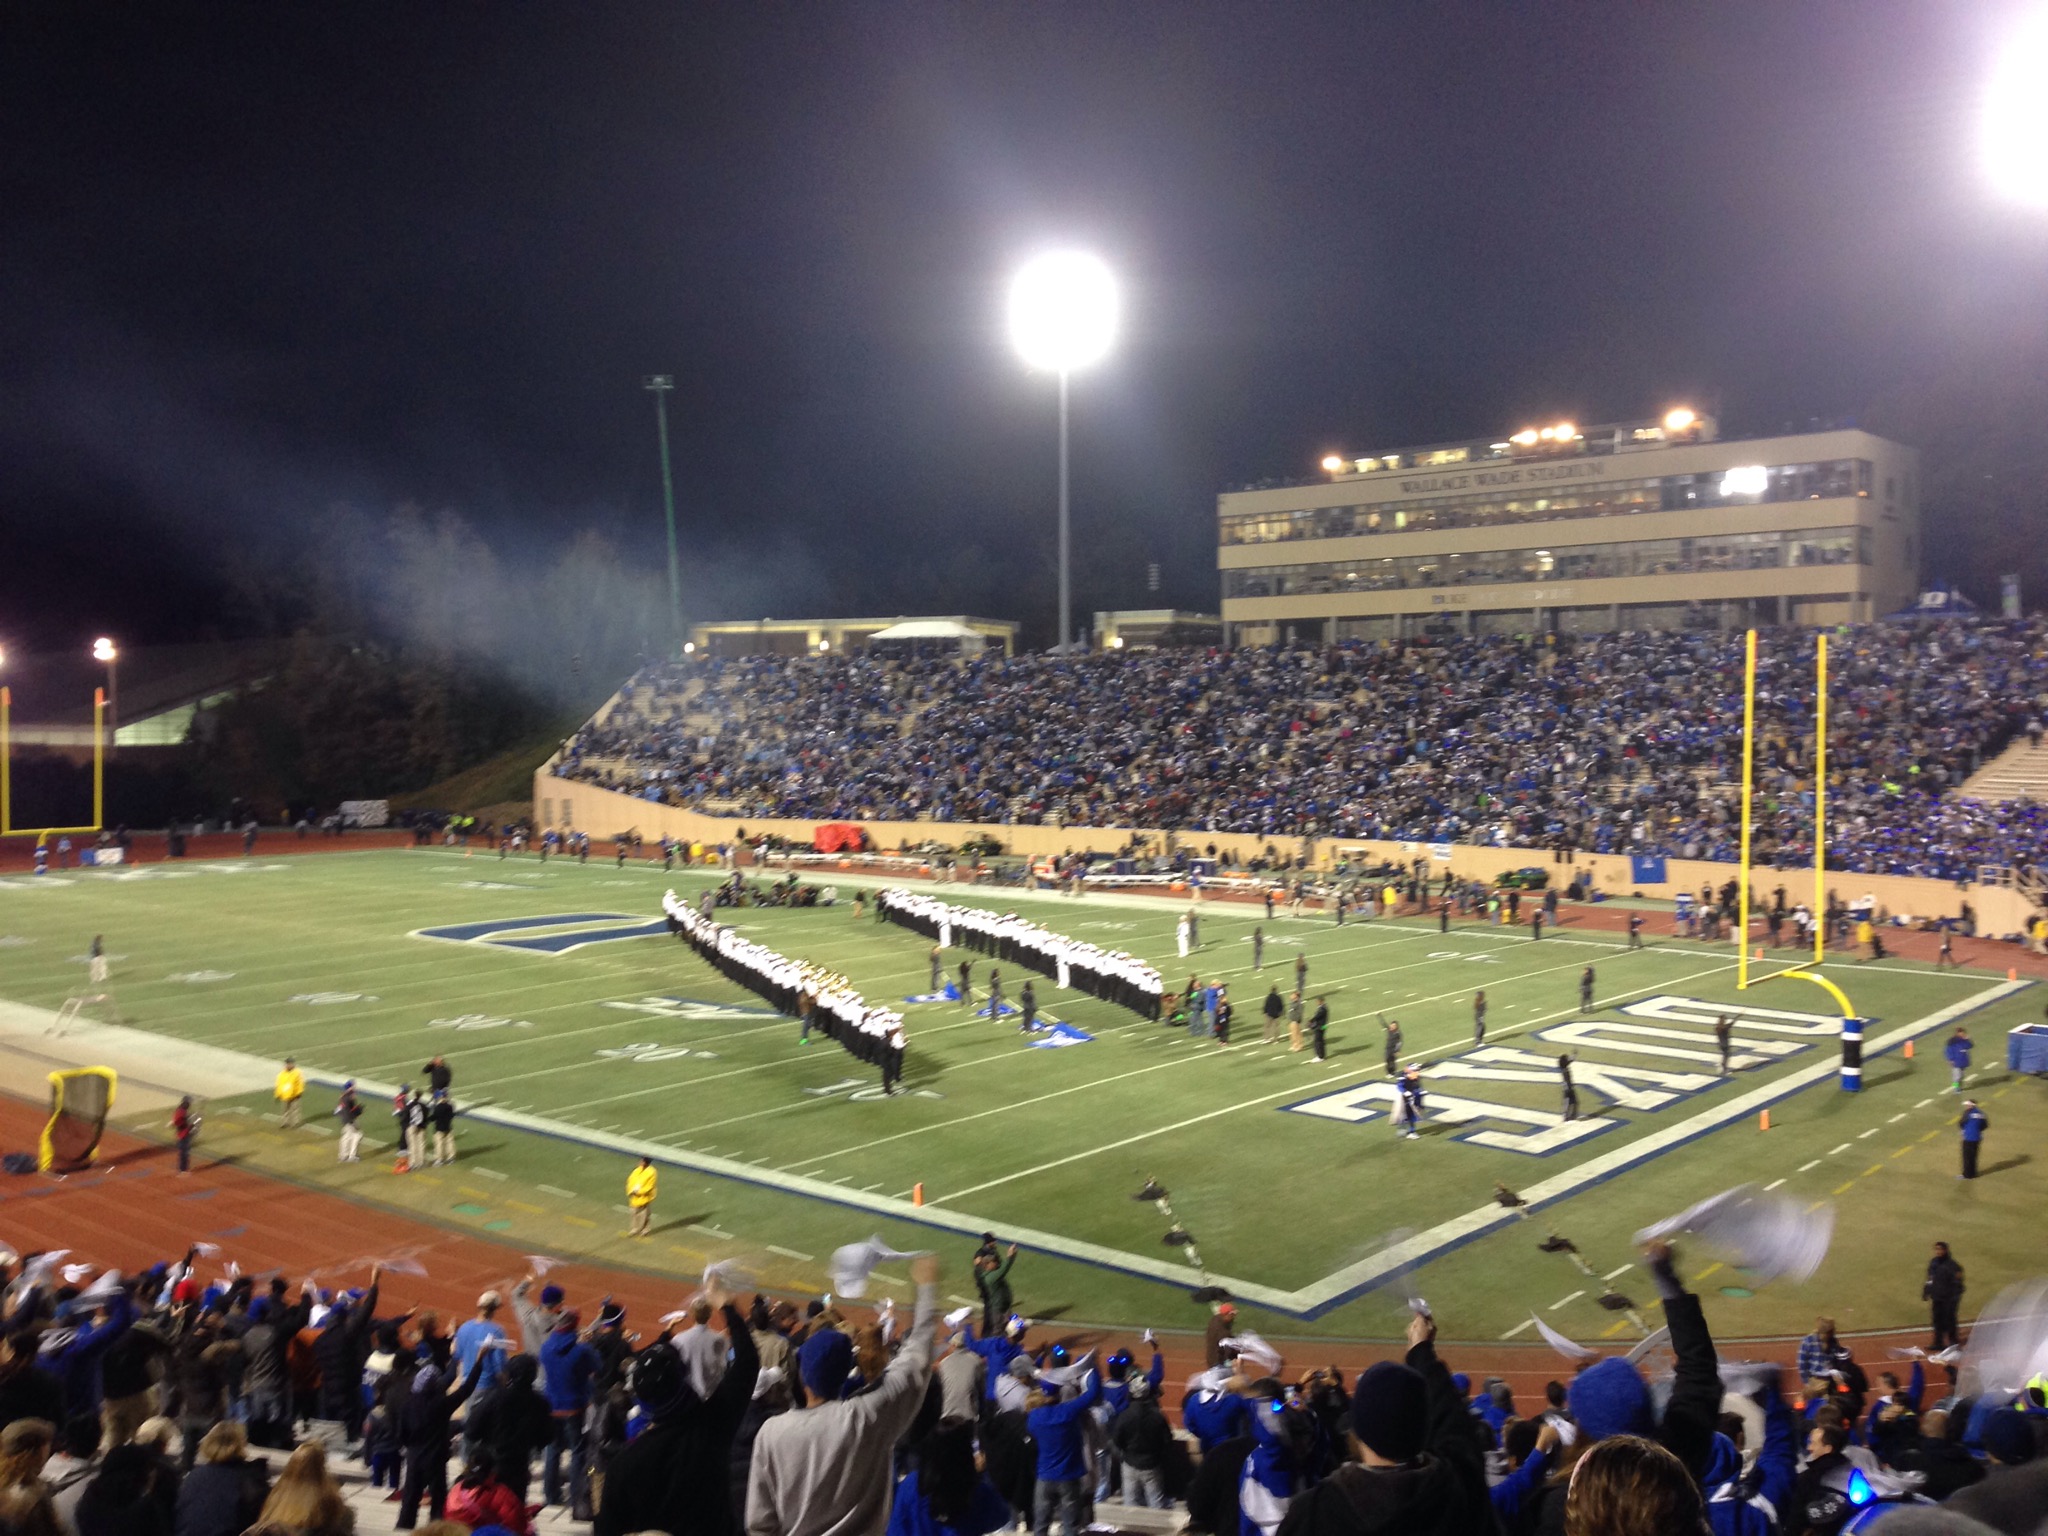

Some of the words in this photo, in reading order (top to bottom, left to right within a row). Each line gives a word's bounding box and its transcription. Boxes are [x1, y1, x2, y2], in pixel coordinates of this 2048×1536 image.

[1401, 475, 1470, 494] WALLACE
[1473, 470, 1520, 487] WADE
[1528, 462, 1604, 482] STADIUM
[1276, 993, 1880, 1158] DUKE
